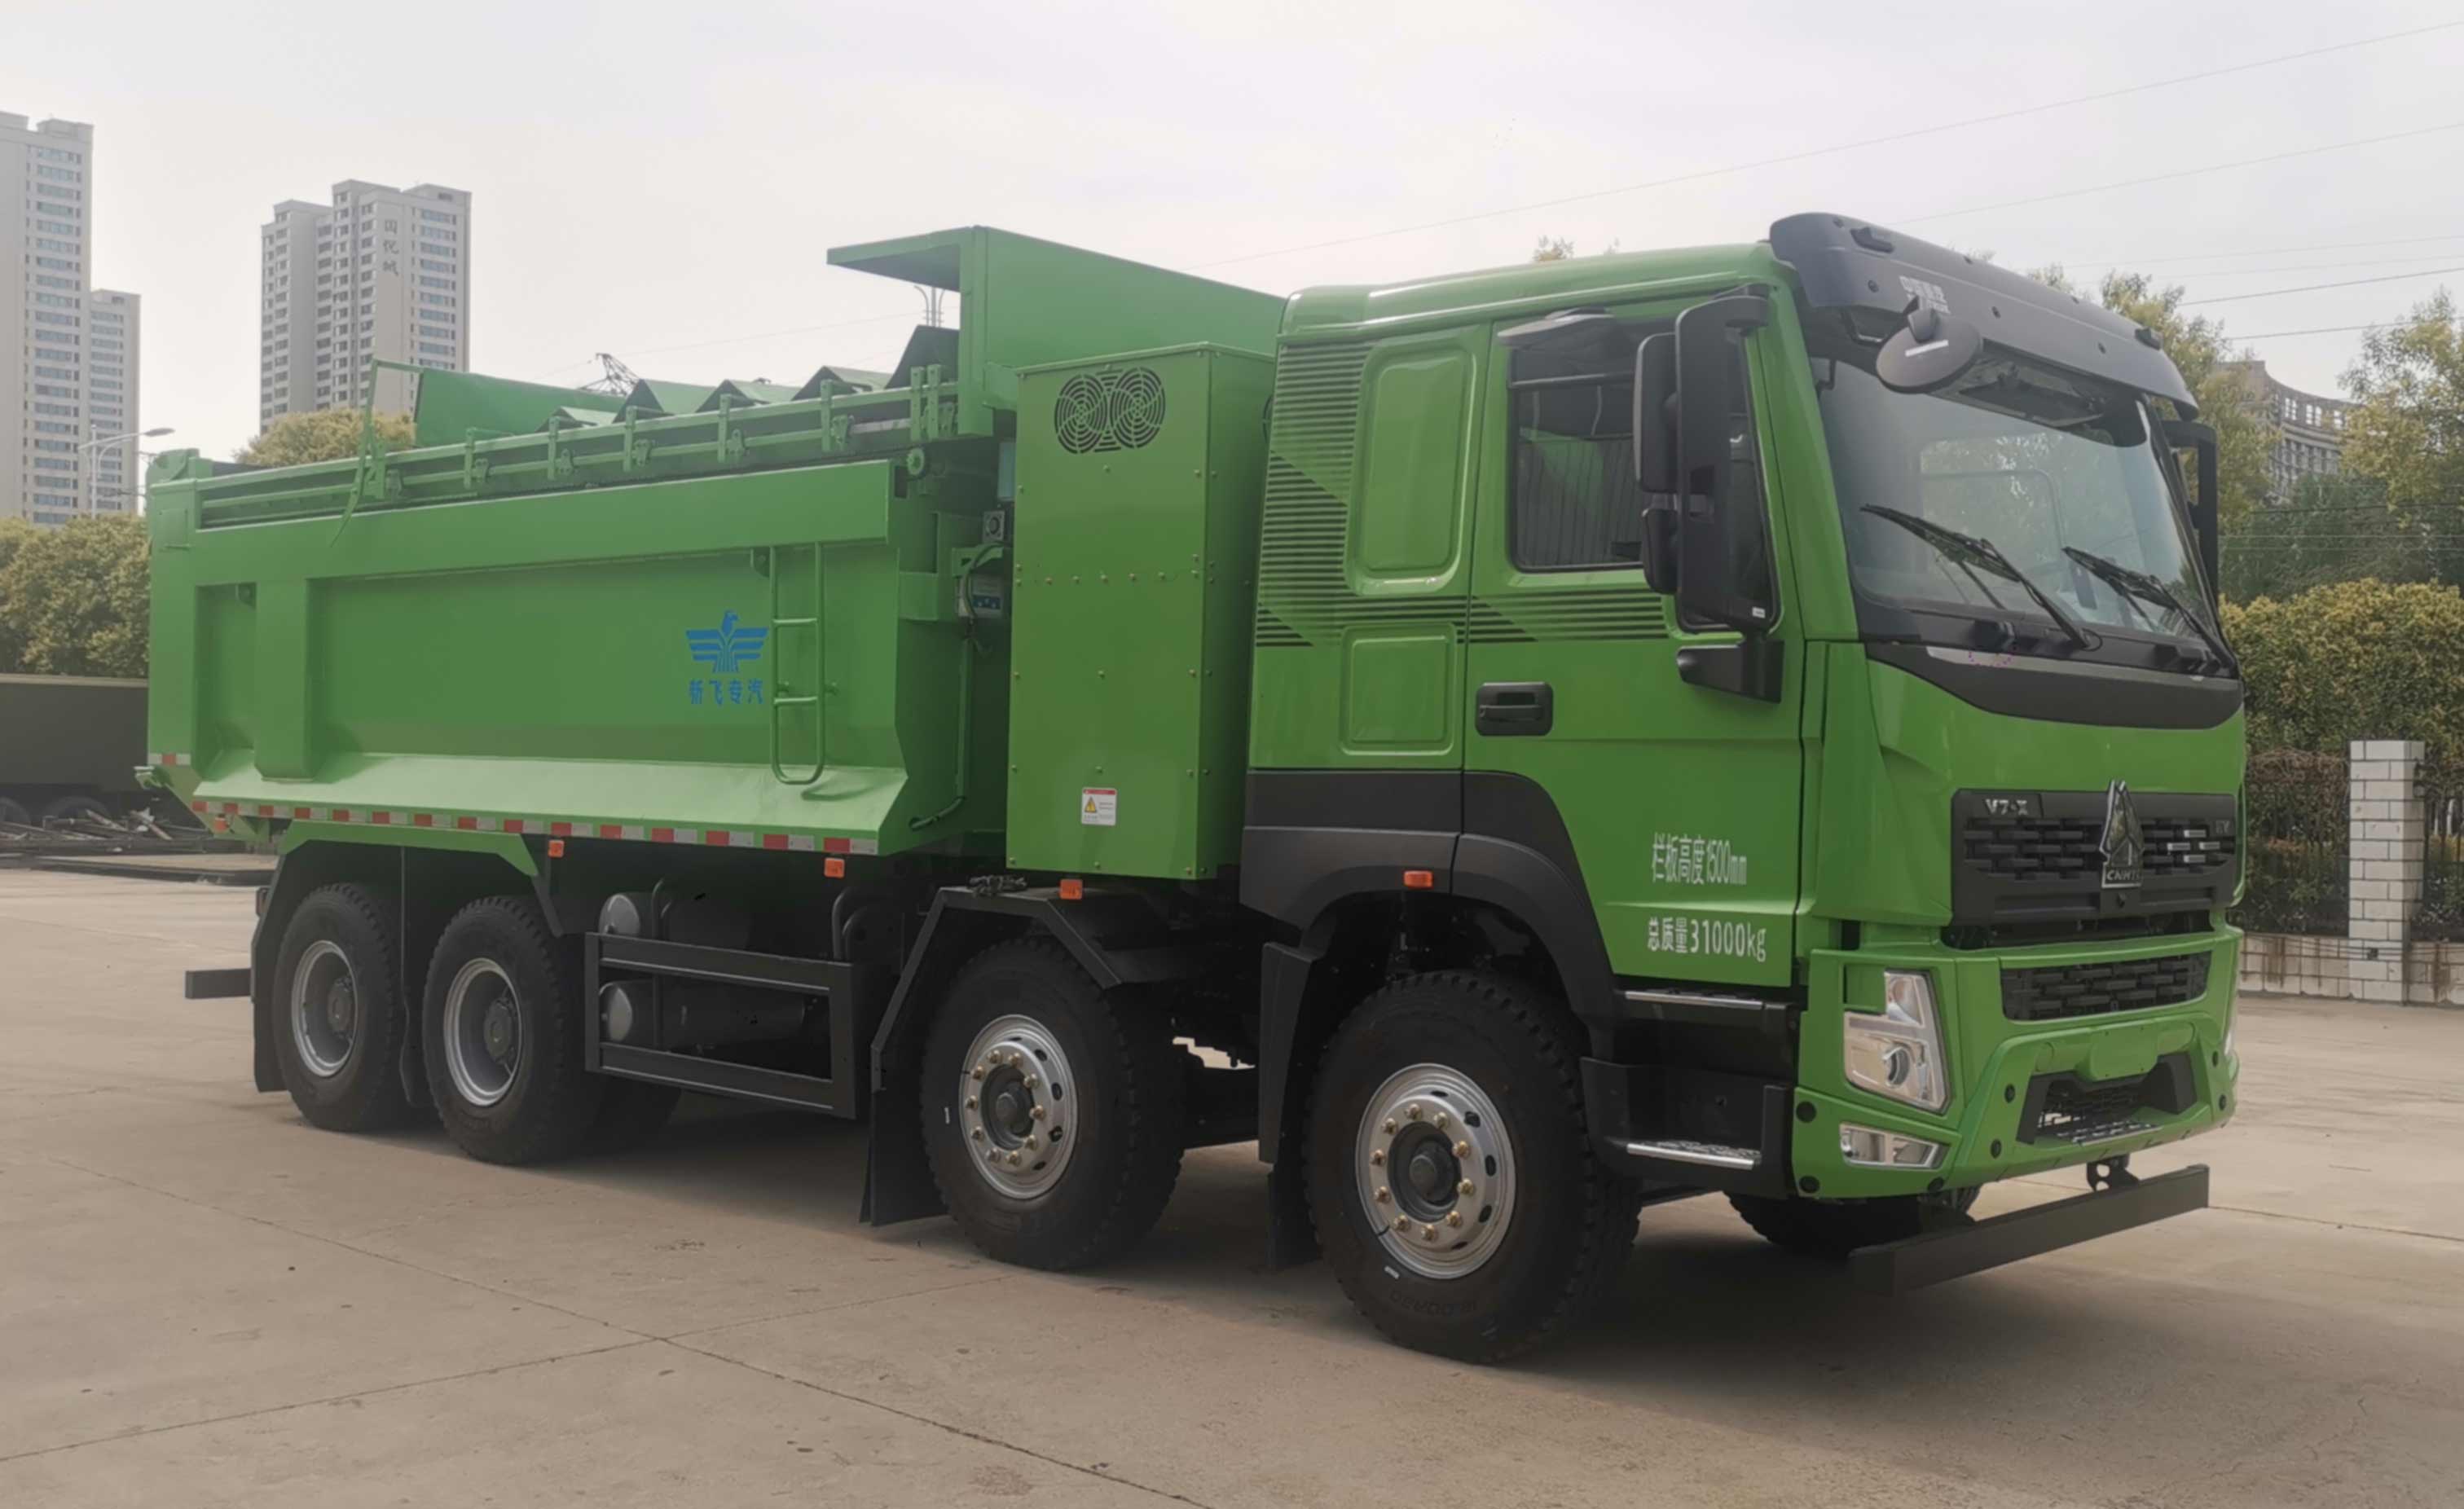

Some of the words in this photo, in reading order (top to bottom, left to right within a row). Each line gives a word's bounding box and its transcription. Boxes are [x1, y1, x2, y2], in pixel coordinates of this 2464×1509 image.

[689, 678, 763, 706] 新飞专汽
[1652, 832, 1747, 886] 栏板高度1500mm
[1648, 917, 1767, 962] 总质量31000kg
